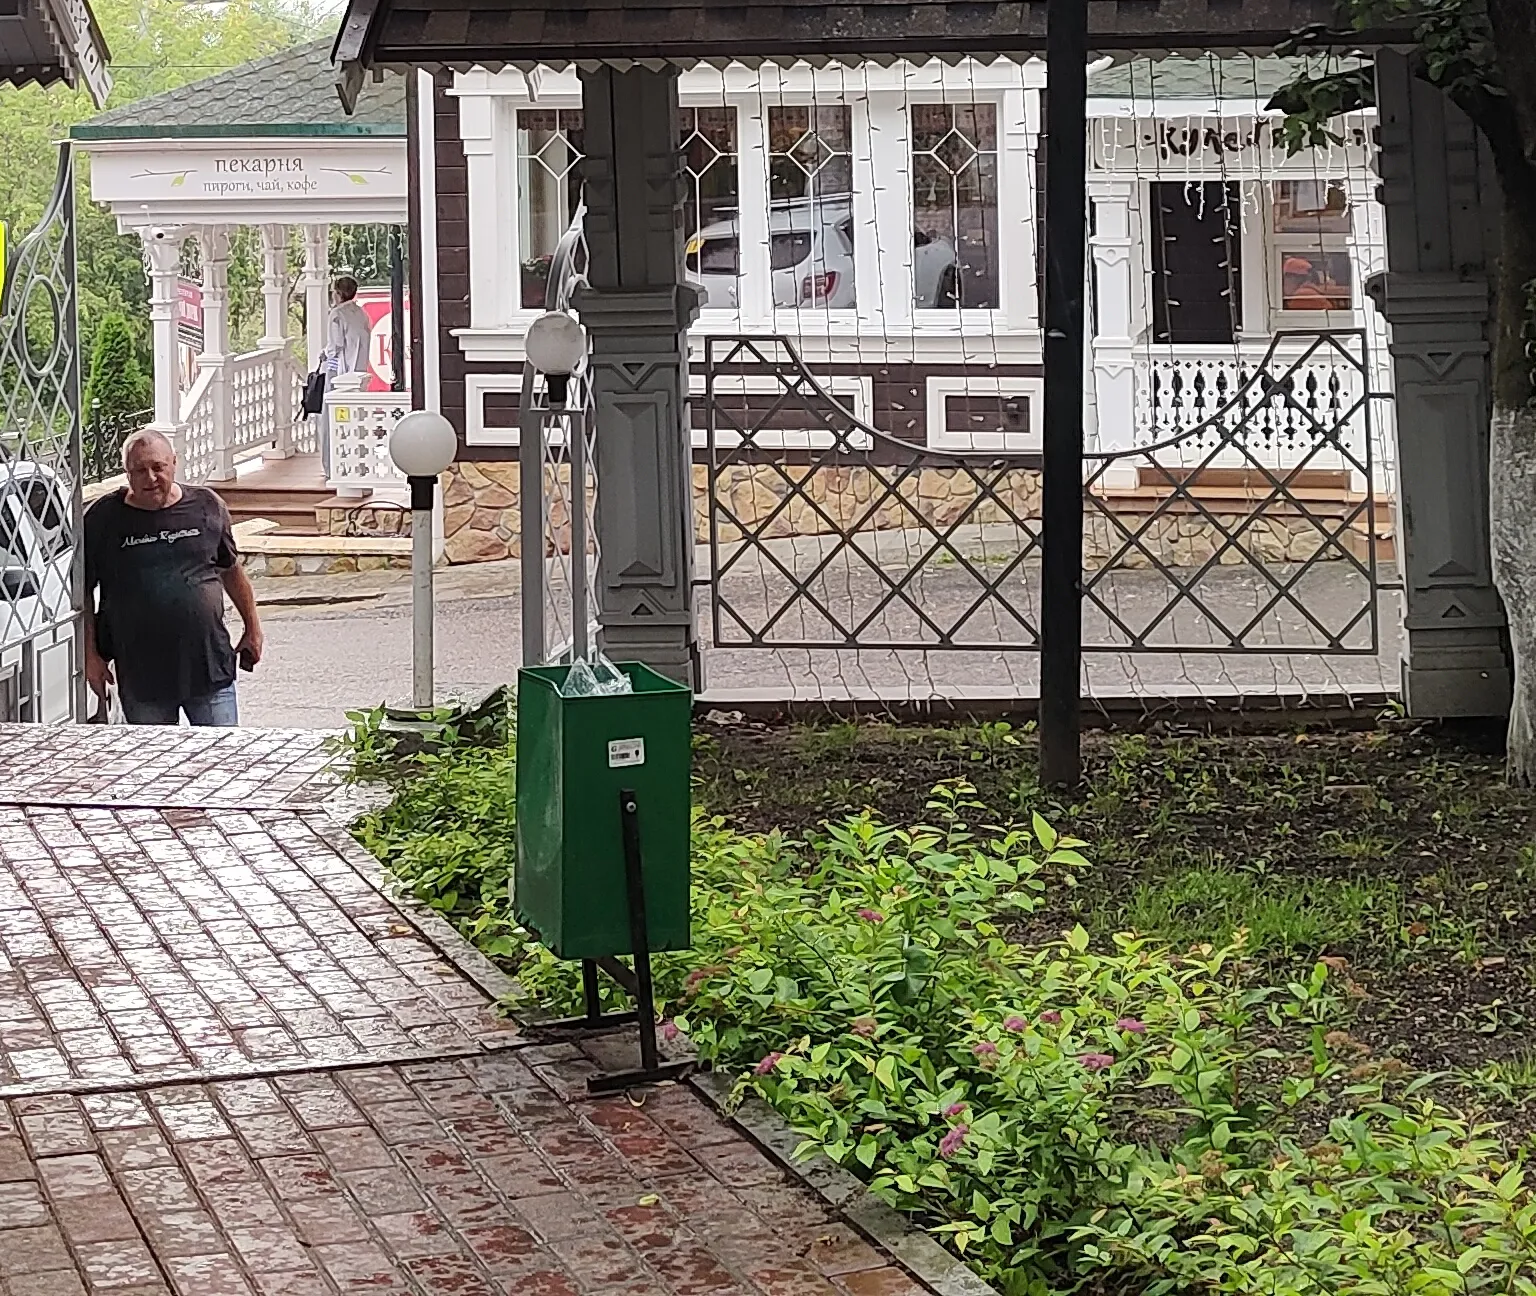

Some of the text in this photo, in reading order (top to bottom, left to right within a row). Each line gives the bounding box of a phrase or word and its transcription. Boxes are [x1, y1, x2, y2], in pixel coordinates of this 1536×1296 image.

[214, 157, 304, 178] пекарня
[203, 174, 318, 196] пироги, чай, кофе
